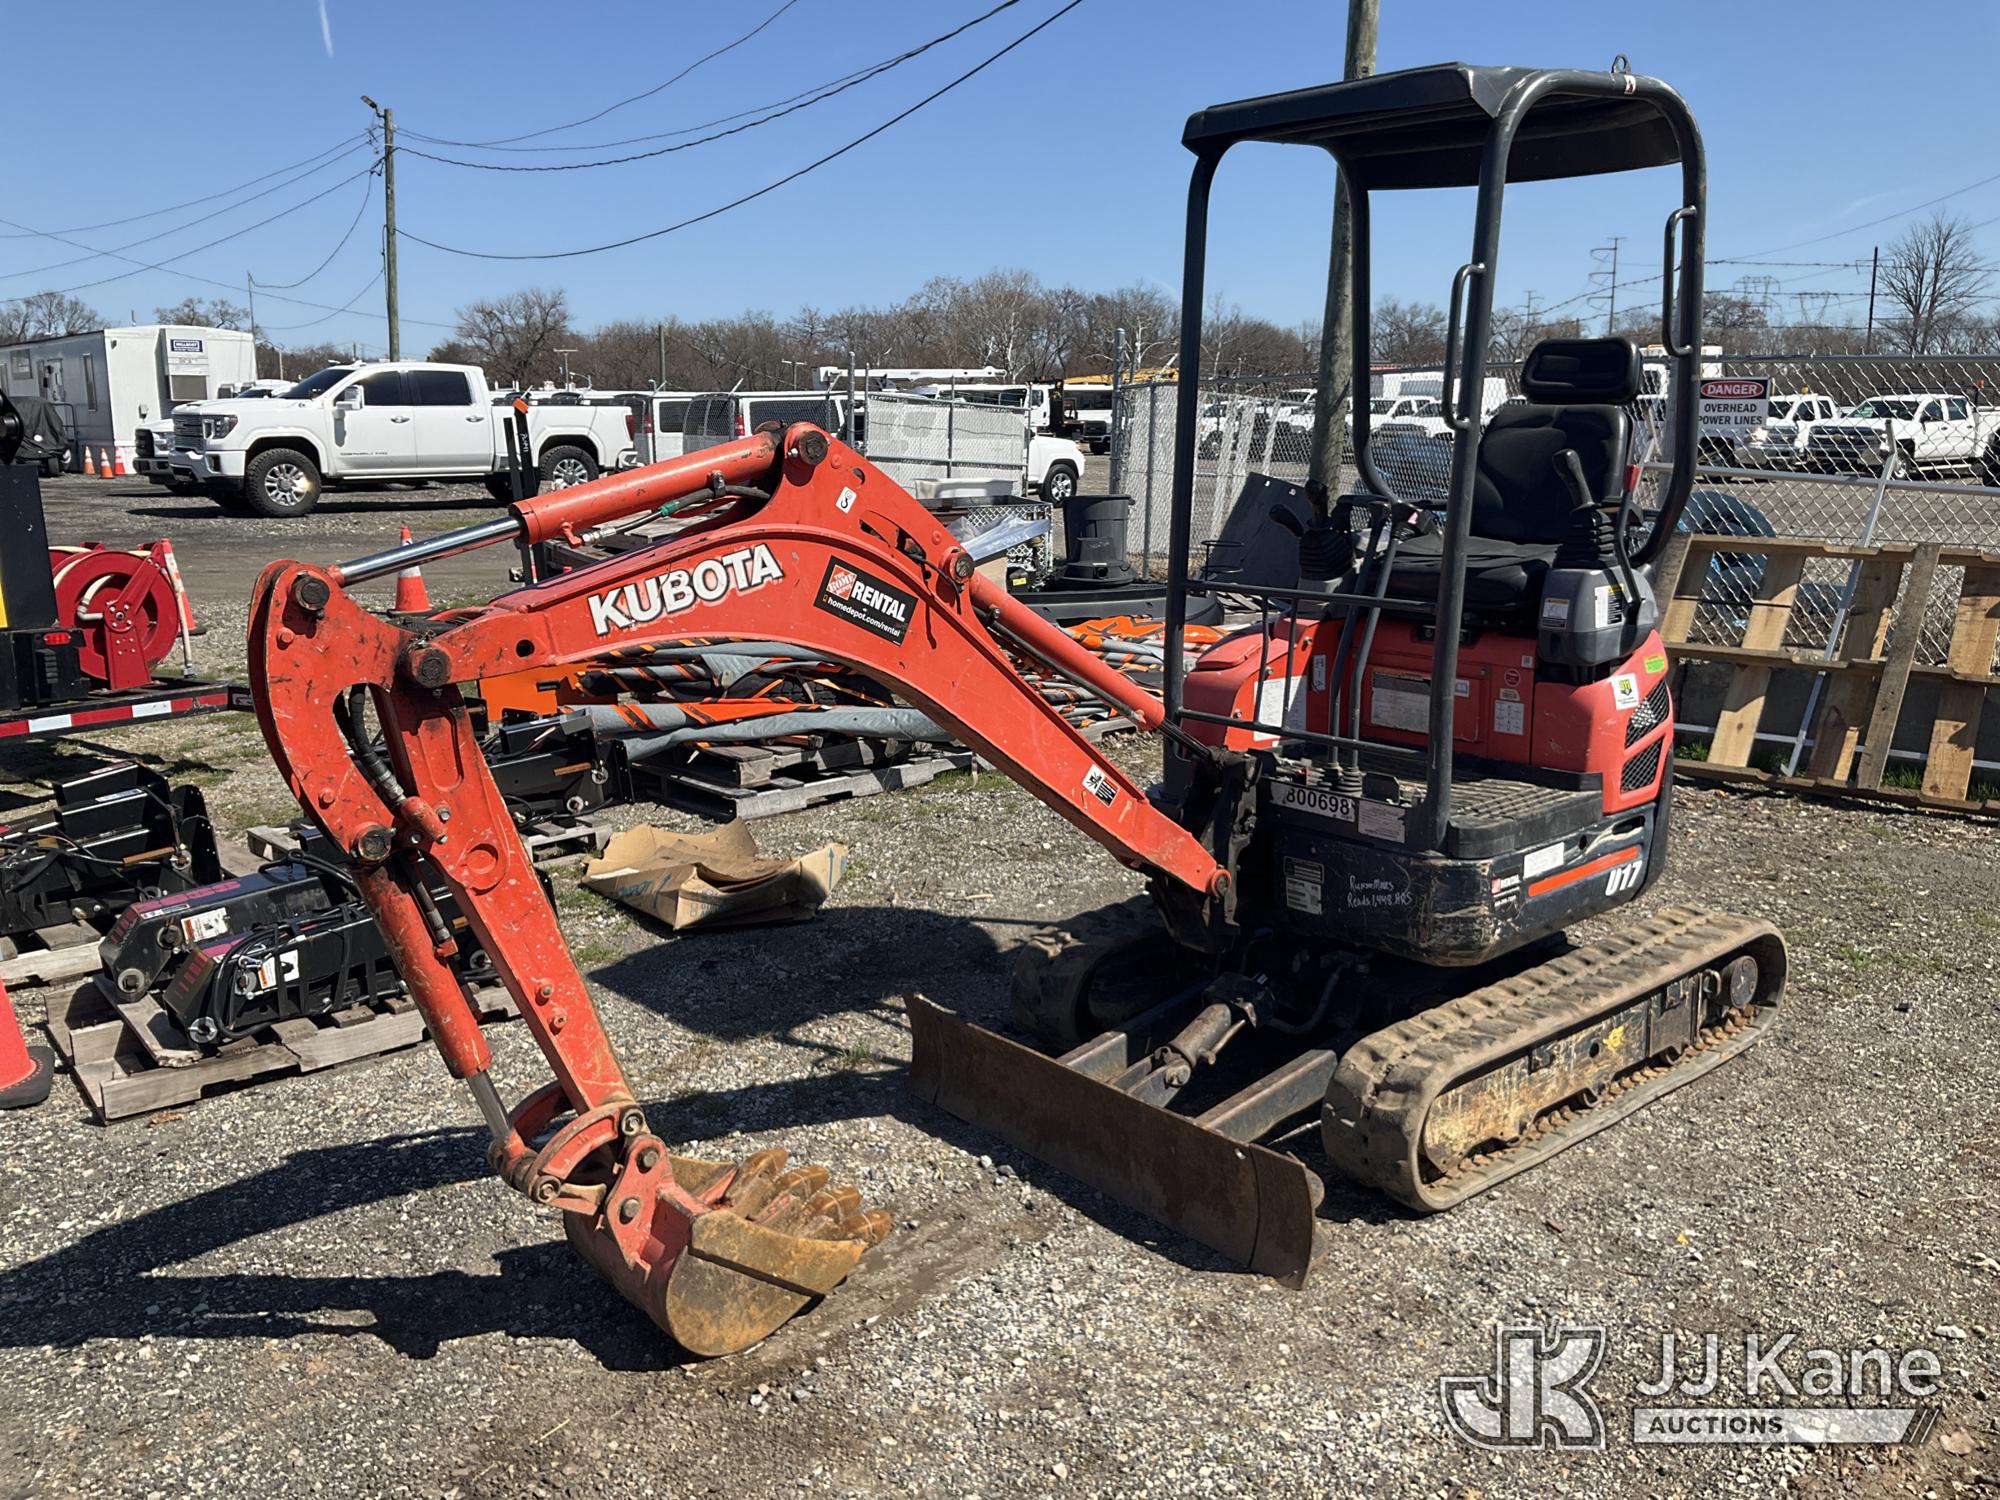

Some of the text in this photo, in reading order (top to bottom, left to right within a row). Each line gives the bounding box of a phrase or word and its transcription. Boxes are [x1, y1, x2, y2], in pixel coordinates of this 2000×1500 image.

[1707, 384, 1758, 395] DANGER
[1704, 403, 1757, 413] OVERHEAD
[1734, 415, 1763, 425] LINES
[588, 543, 784, 635] KUBOTA
[828, 574, 853, 592] HOME
[851, 580, 906, 622] RENTAL
[828, 596, 900, 637] homedepot.com/rental
[1605, 860, 1643, 896] U17
